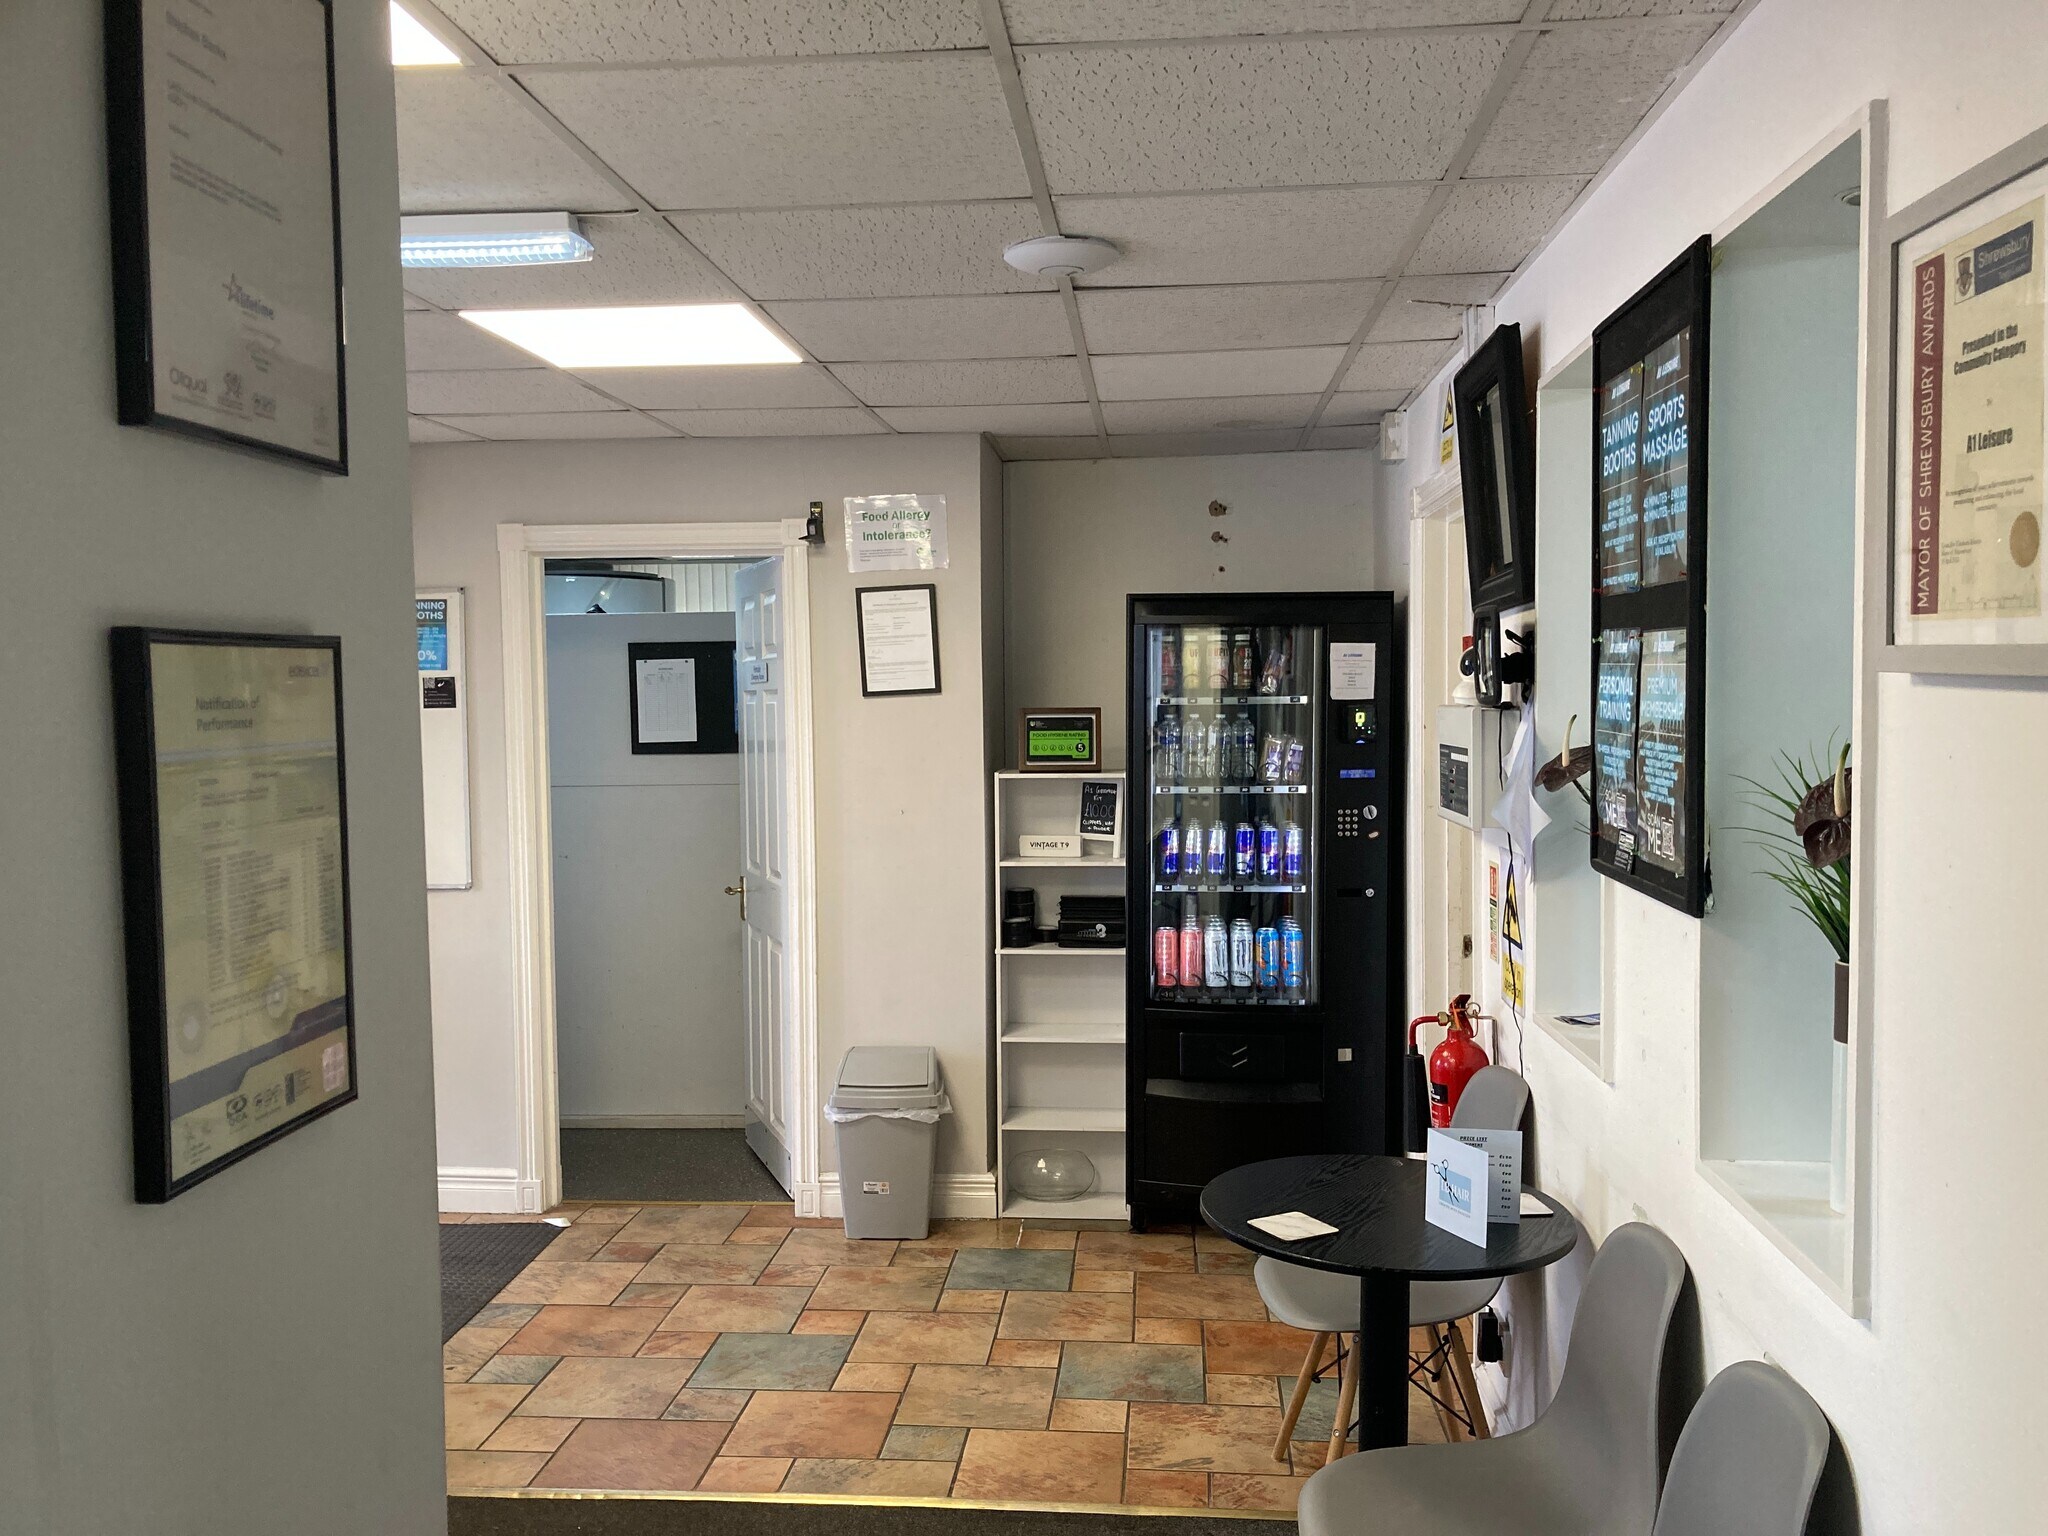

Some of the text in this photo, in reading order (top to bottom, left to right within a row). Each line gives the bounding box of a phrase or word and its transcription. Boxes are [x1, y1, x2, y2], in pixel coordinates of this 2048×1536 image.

[1962, 330, 1996, 356] Presented
[1954, 340, 2027, 376] Community Category
[1647, 393, 1685, 433] SPORTS
[1602, 411, 1639, 449] TANNING
[1917, 265, 1936, 608] MAYOR OF SHREWSBURY AWARDS
[1966, 427, 2013, 454] A1 Leisure
[1643, 424, 1688, 466] MASSAGE
[1603, 442, 1636, 477] BOOTHS
[862, 510, 931, 522] Food Allergy
[863, 528, 932, 541] Intolerance?
[1598, 674, 1634, 697] PERSONAL
[1646, 676, 1678, 696] PREMIUM
[1599, 699, 1632, 722] TRAINING
[197, 717, 253, 731] Performance
[1078, 744, 1084, 752] 5
[1604, 800, 1618, 829] ME
[1647, 813, 1662, 829] SCAN
[1029, 841, 1059, 850] VINTAGE
[1648, 826, 1662, 857] ME
[1451, 1183, 1471, 1202] HAIR
